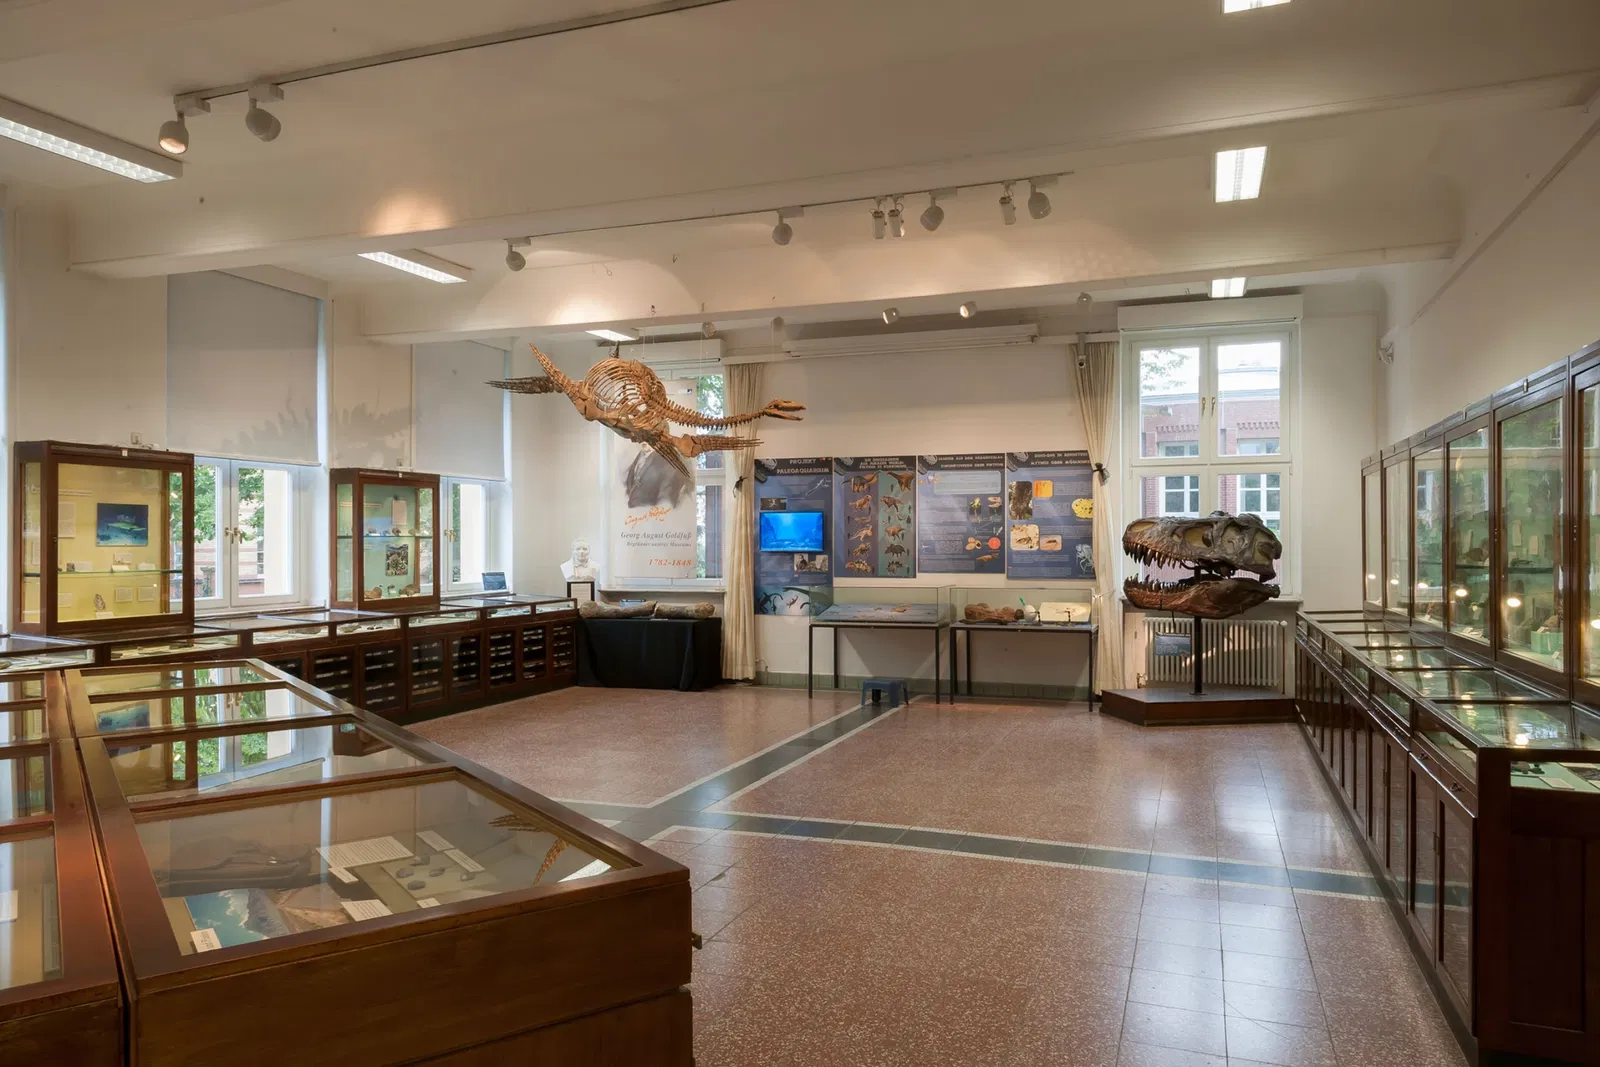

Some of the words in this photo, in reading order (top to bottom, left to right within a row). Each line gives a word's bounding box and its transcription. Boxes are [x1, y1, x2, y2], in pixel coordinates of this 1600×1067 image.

[620, 532, 640, 540] Georg
[642, 532, 664, 540] August
[648, 558, 692, 566] 1782-1848
